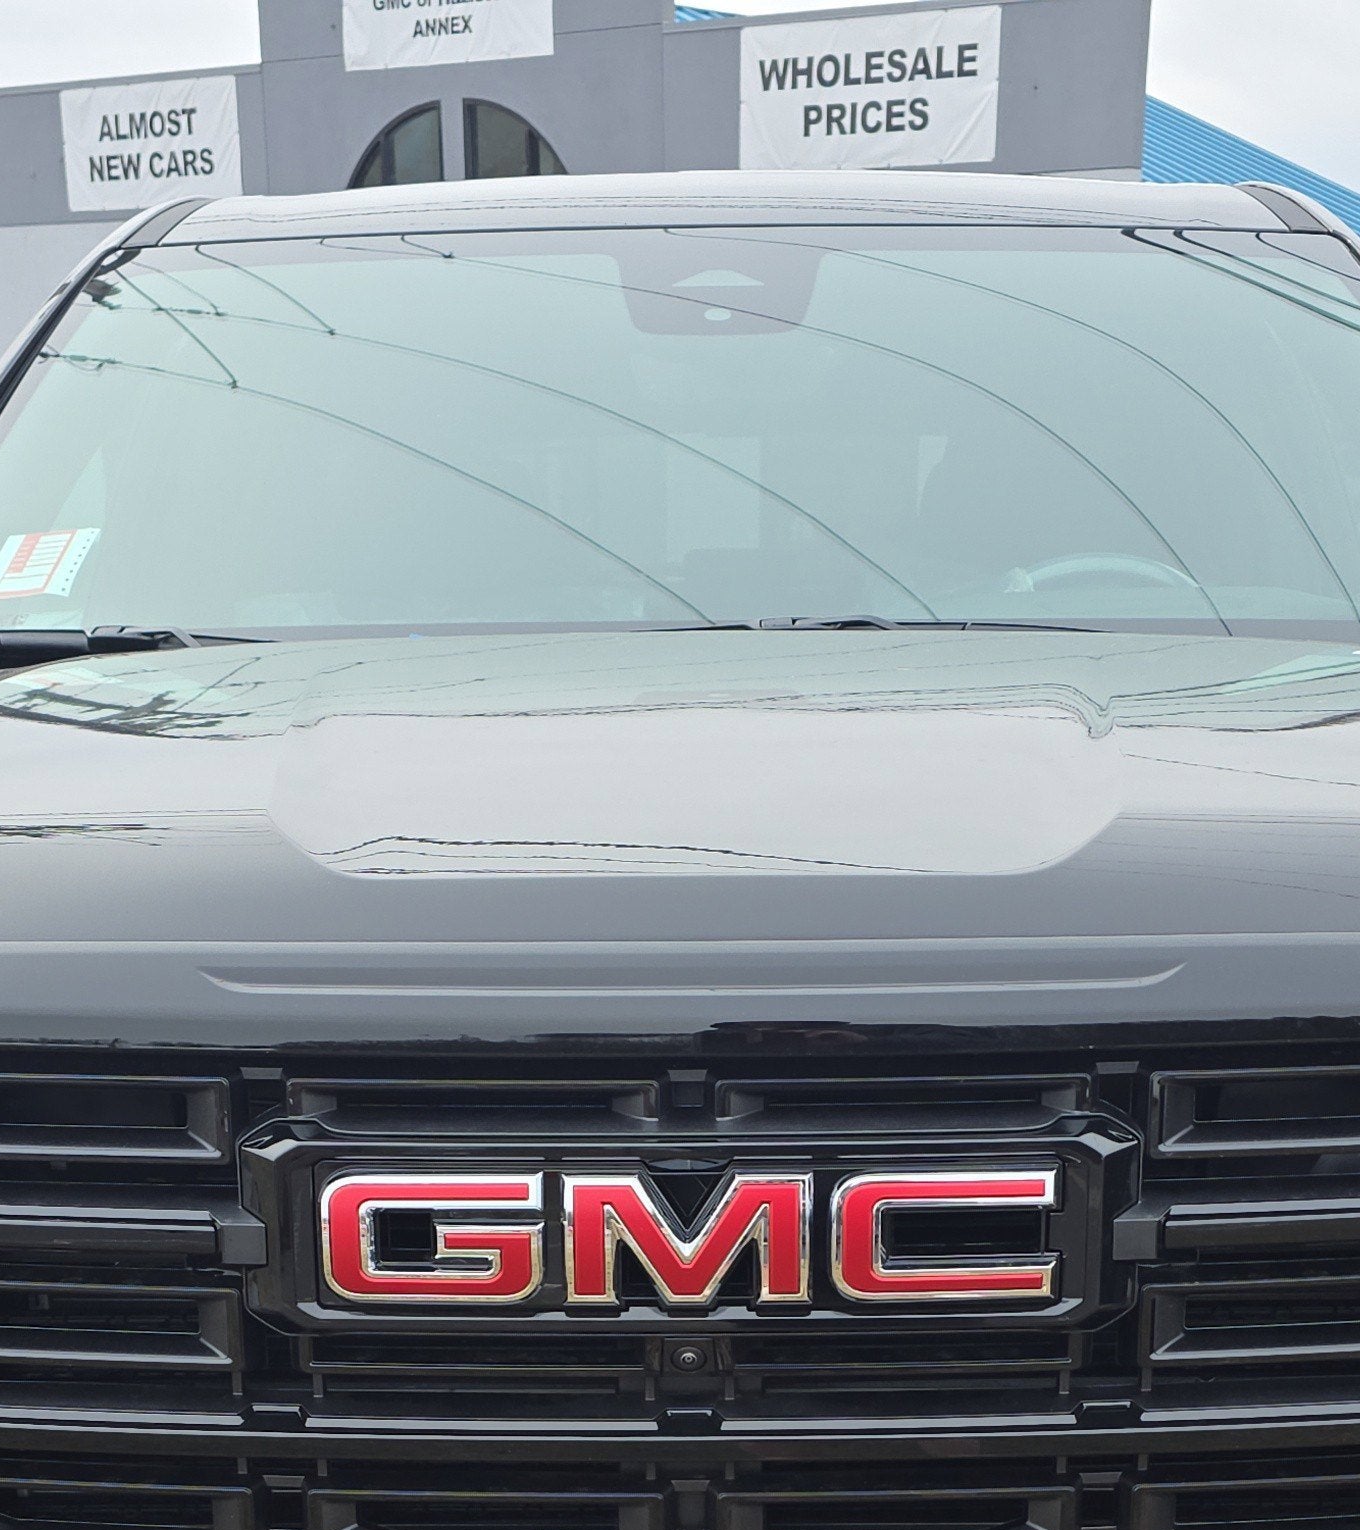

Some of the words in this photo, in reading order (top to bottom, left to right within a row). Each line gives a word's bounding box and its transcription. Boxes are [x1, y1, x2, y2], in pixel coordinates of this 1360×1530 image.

[413, 15, 473, 37] ANNEX
[759, 43, 979, 91] WHOLESALE
[99, 107, 197, 141] ALMOST
[803, 97, 929, 137] PRICES
[89, 153, 141, 182] NEW
[149, 149, 215, 178] CARS
[320, 1169, 1058, 1305] GMC
